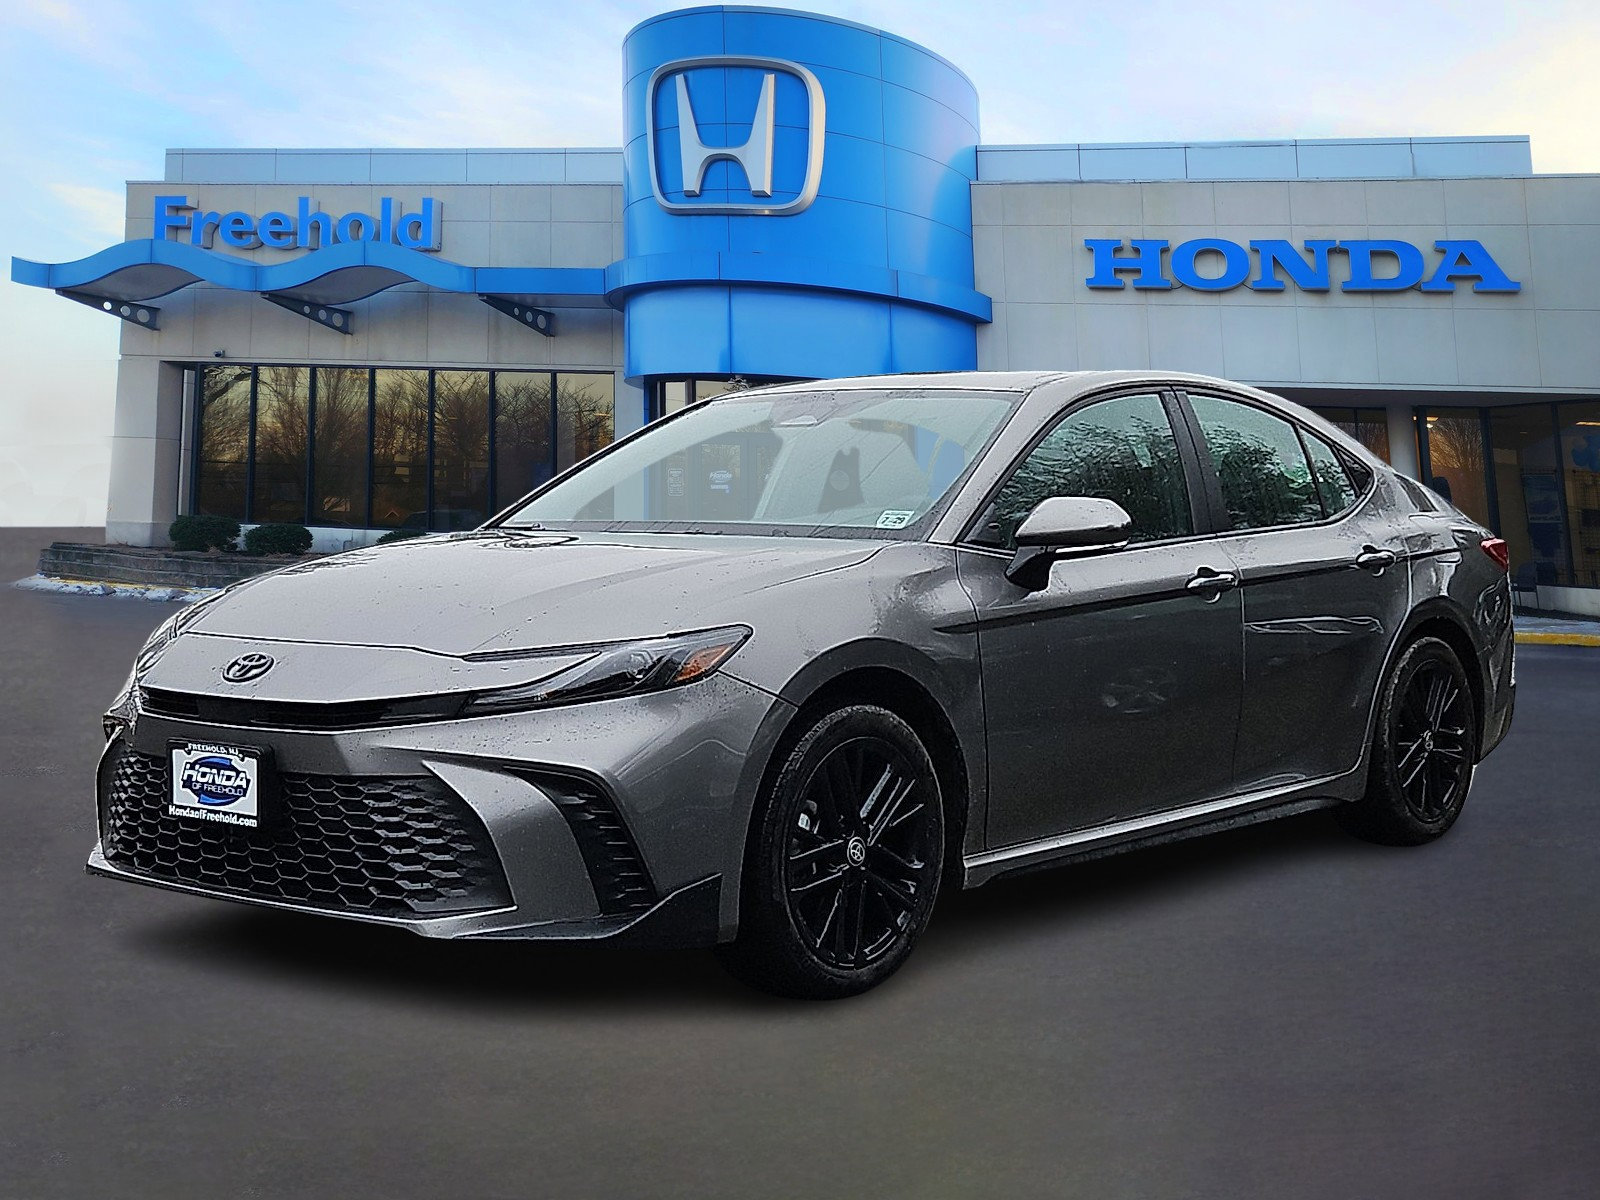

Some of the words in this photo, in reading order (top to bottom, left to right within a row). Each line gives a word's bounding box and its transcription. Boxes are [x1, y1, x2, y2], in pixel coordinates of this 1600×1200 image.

[153, 195, 442, 250] Freehold
[1084, 238, 1521, 292] HONDA
[183, 763, 247, 788] HONDA
[192, 782, 202, 790] OF
[203, 784, 244, 796] FREEHOLD
[169, 805, 258, 827] HondaofFreehold.com
